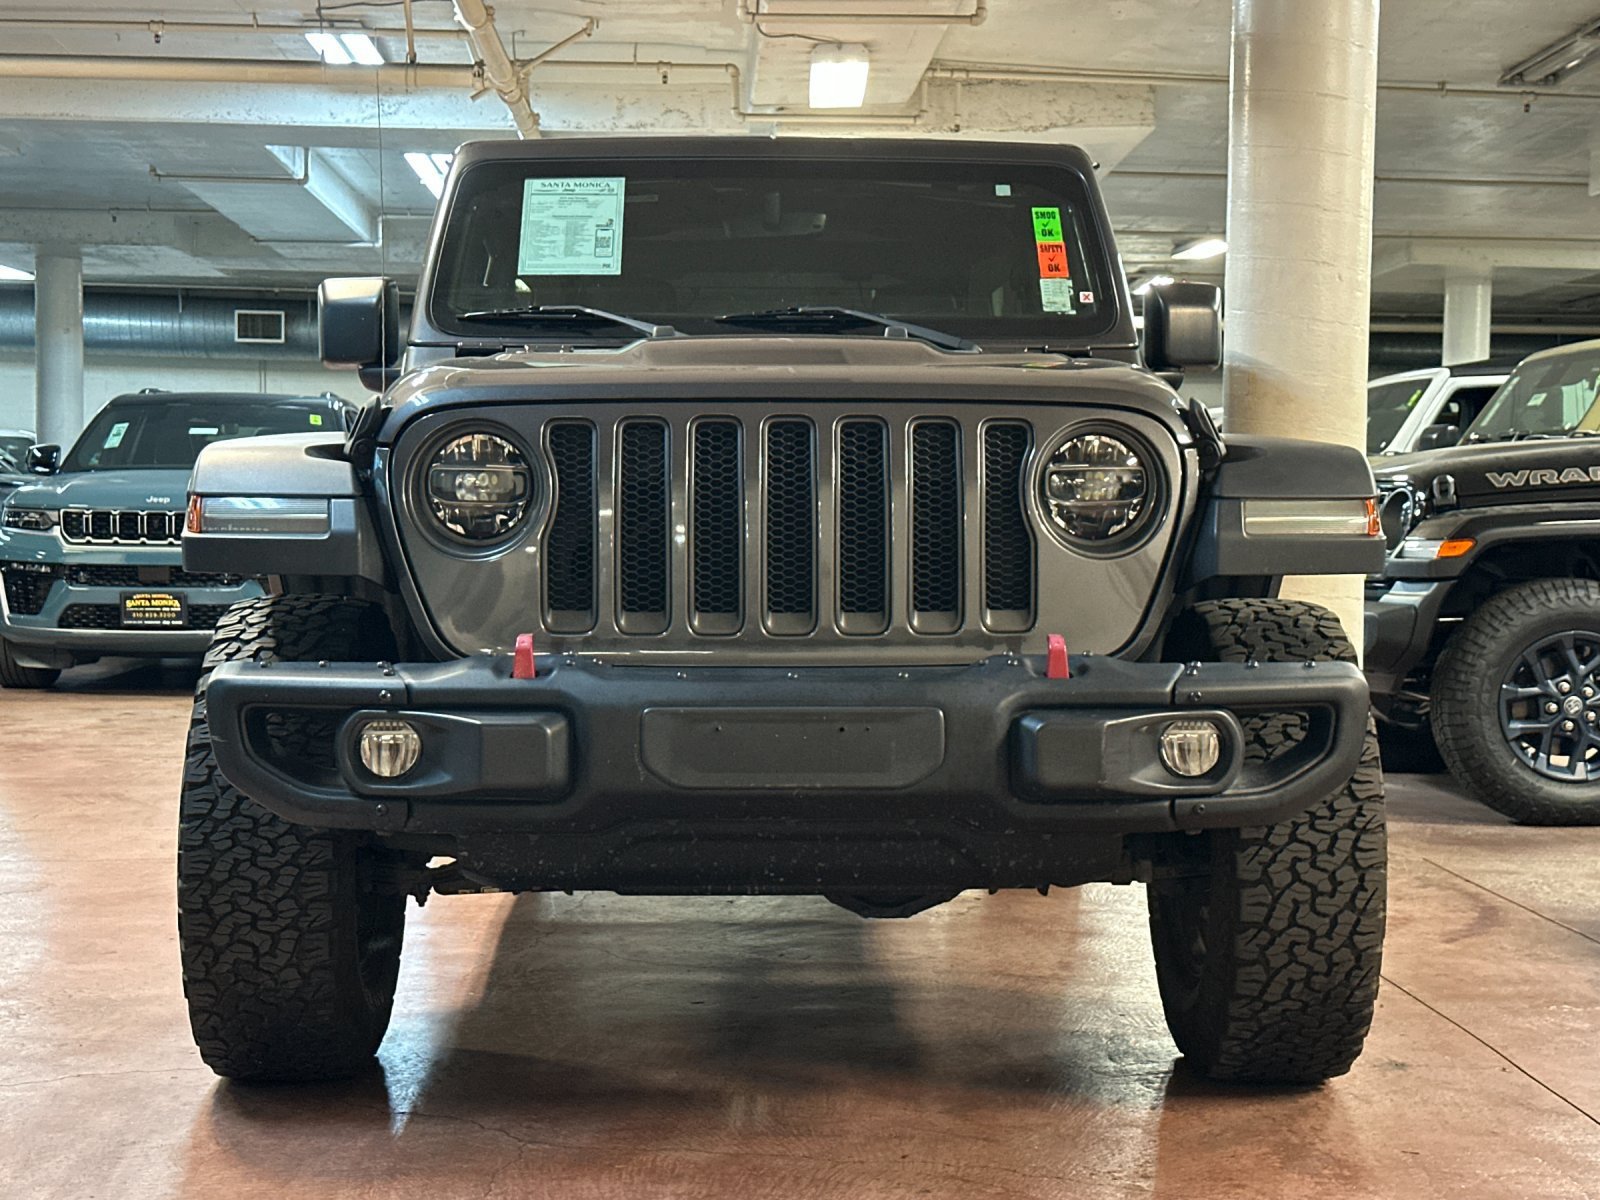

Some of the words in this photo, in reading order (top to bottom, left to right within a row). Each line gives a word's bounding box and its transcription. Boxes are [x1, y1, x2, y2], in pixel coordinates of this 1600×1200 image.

[1035, 211, 1056, 220] SMOG
[1041, 228, 1054, 237] OK
[1040, 244, 1062, 253] SAFETY
[1048, 263, 1061, 272] OK
[145, 495, 171, 504] Jeep
[126, 600, 150, 608] SANTA
[151, 600, 181, 608] MONICA
